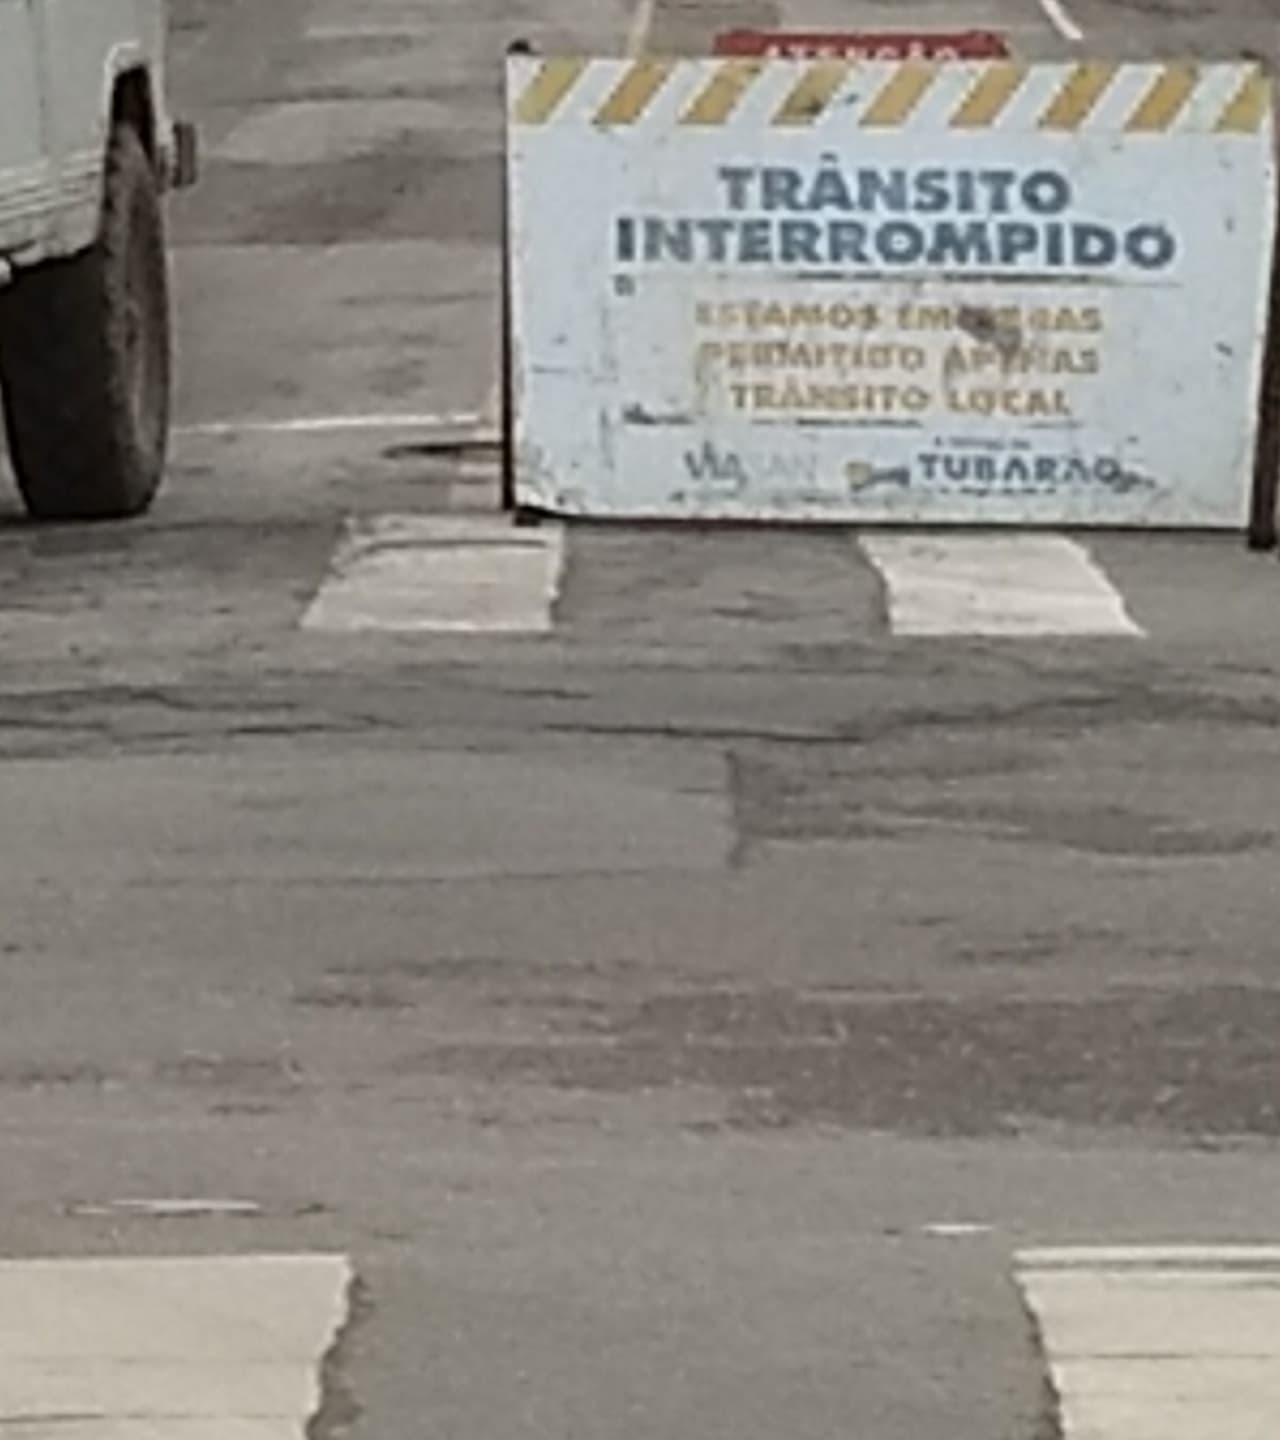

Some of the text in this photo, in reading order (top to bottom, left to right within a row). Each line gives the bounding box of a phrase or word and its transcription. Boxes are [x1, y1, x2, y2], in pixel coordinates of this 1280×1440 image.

[719, 154, 1073, 215] TRÂNSITO
[615, 216, 1177, 270] INTERROMPIDO
[696, 301, 880, 330] ESTAMOS
[700, 342, 926, 372] PERMITIDO
[946, 388, 1071, 416] LOCAL
